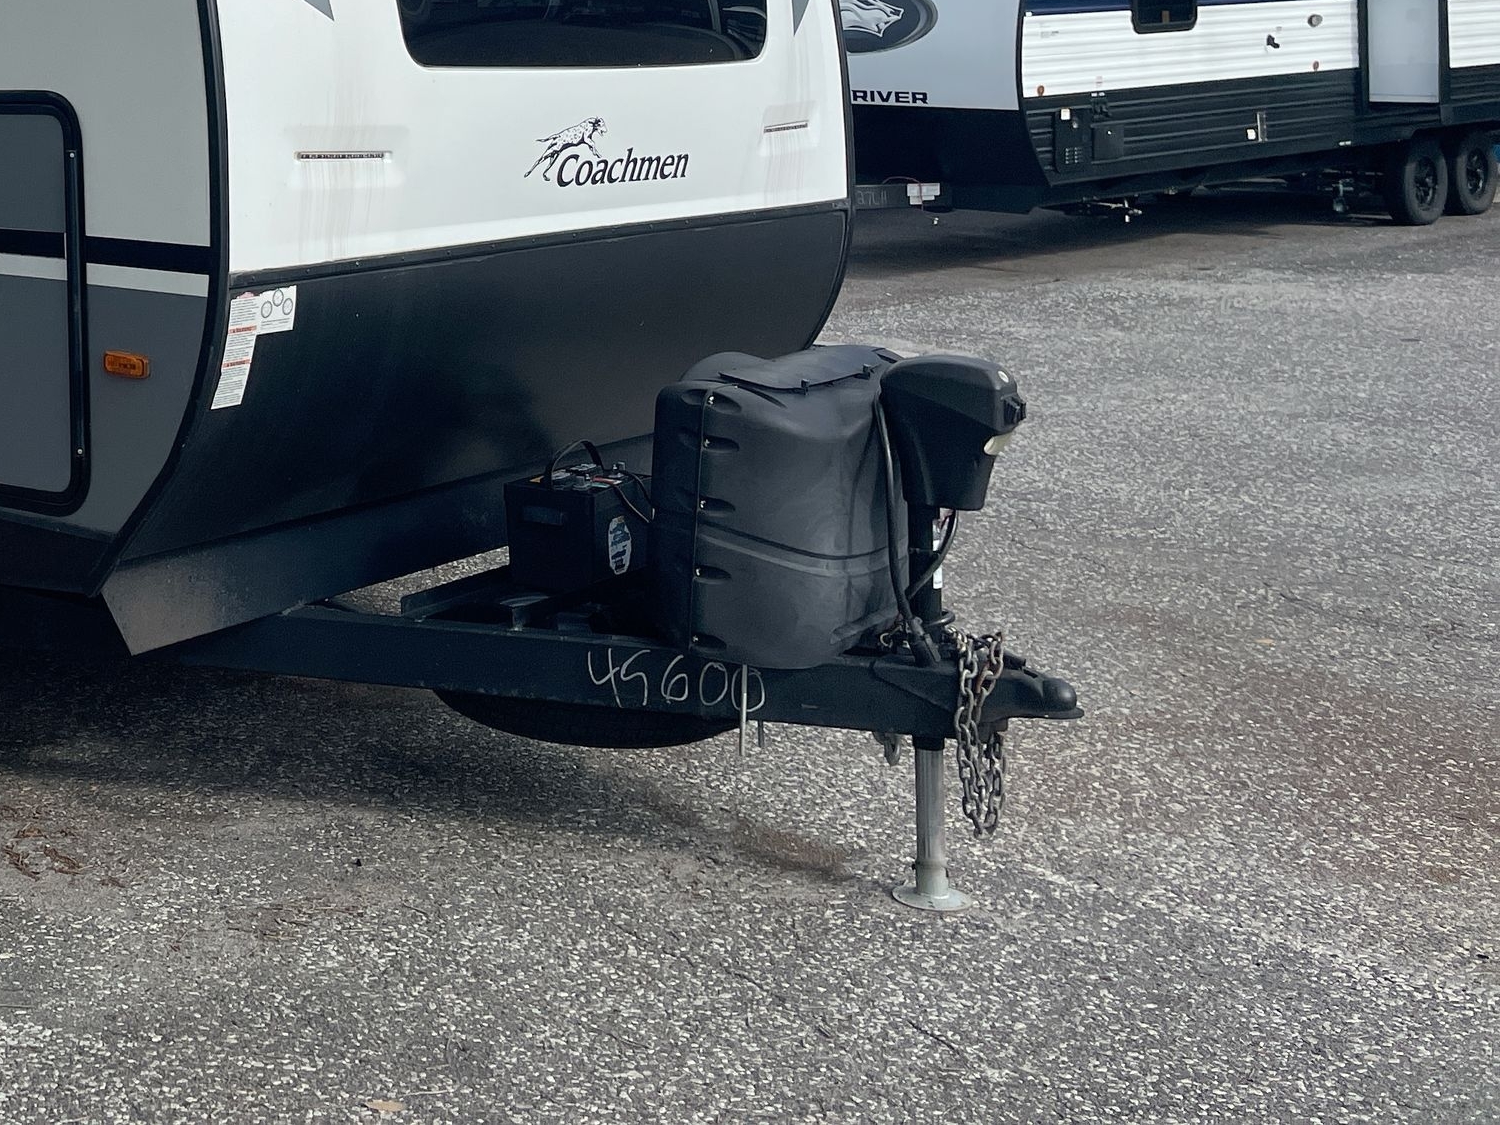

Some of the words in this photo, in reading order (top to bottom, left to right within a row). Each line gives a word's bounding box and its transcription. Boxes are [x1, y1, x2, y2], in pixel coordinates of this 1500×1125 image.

[851, 90, 928, 104] RIVER
[557, 147, 689, 187] Coachmen
[587, 648, 766, 713] 45600
